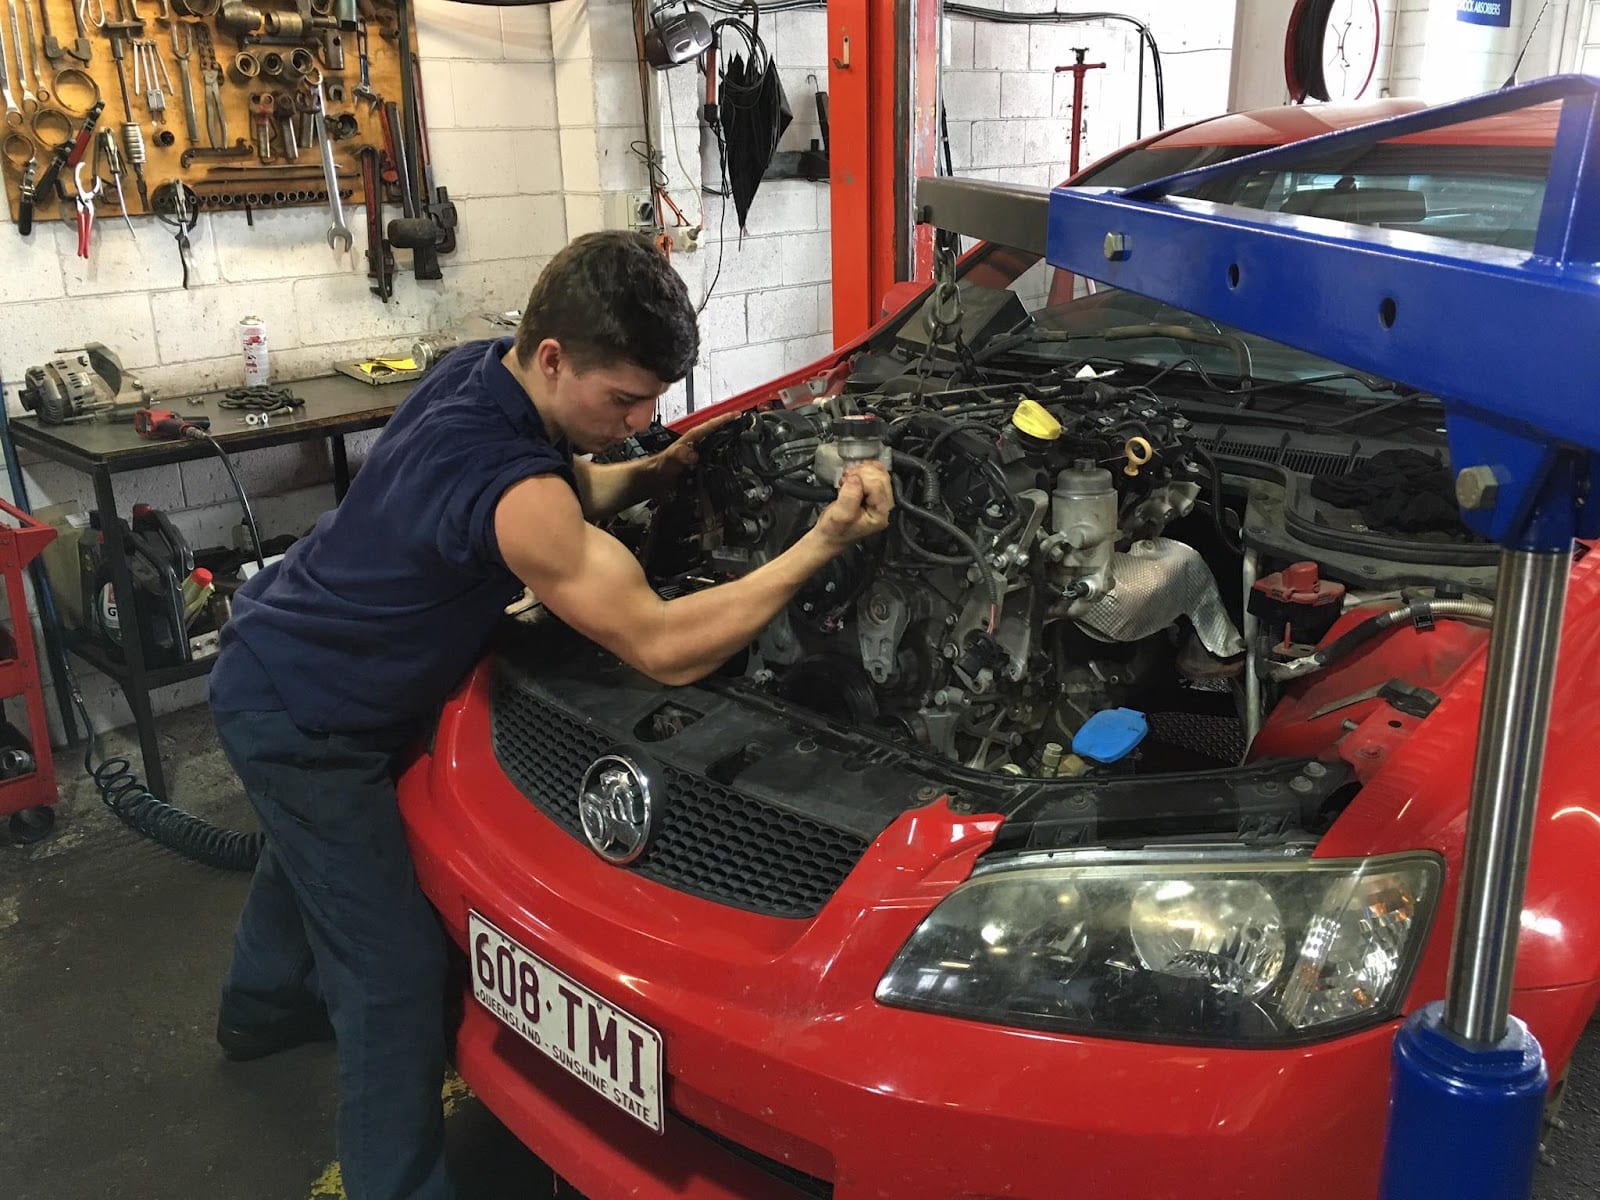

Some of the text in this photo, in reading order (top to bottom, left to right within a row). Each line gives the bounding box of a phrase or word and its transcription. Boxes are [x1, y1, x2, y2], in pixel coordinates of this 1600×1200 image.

[1474, 1, 1501, 15] ABSORBERS
[479, 989, 541, 1044] QUEENSLAND
[552, 1044, 608, 1095] SUNSHINE
[613, 1087, 651, 1122] STATE
